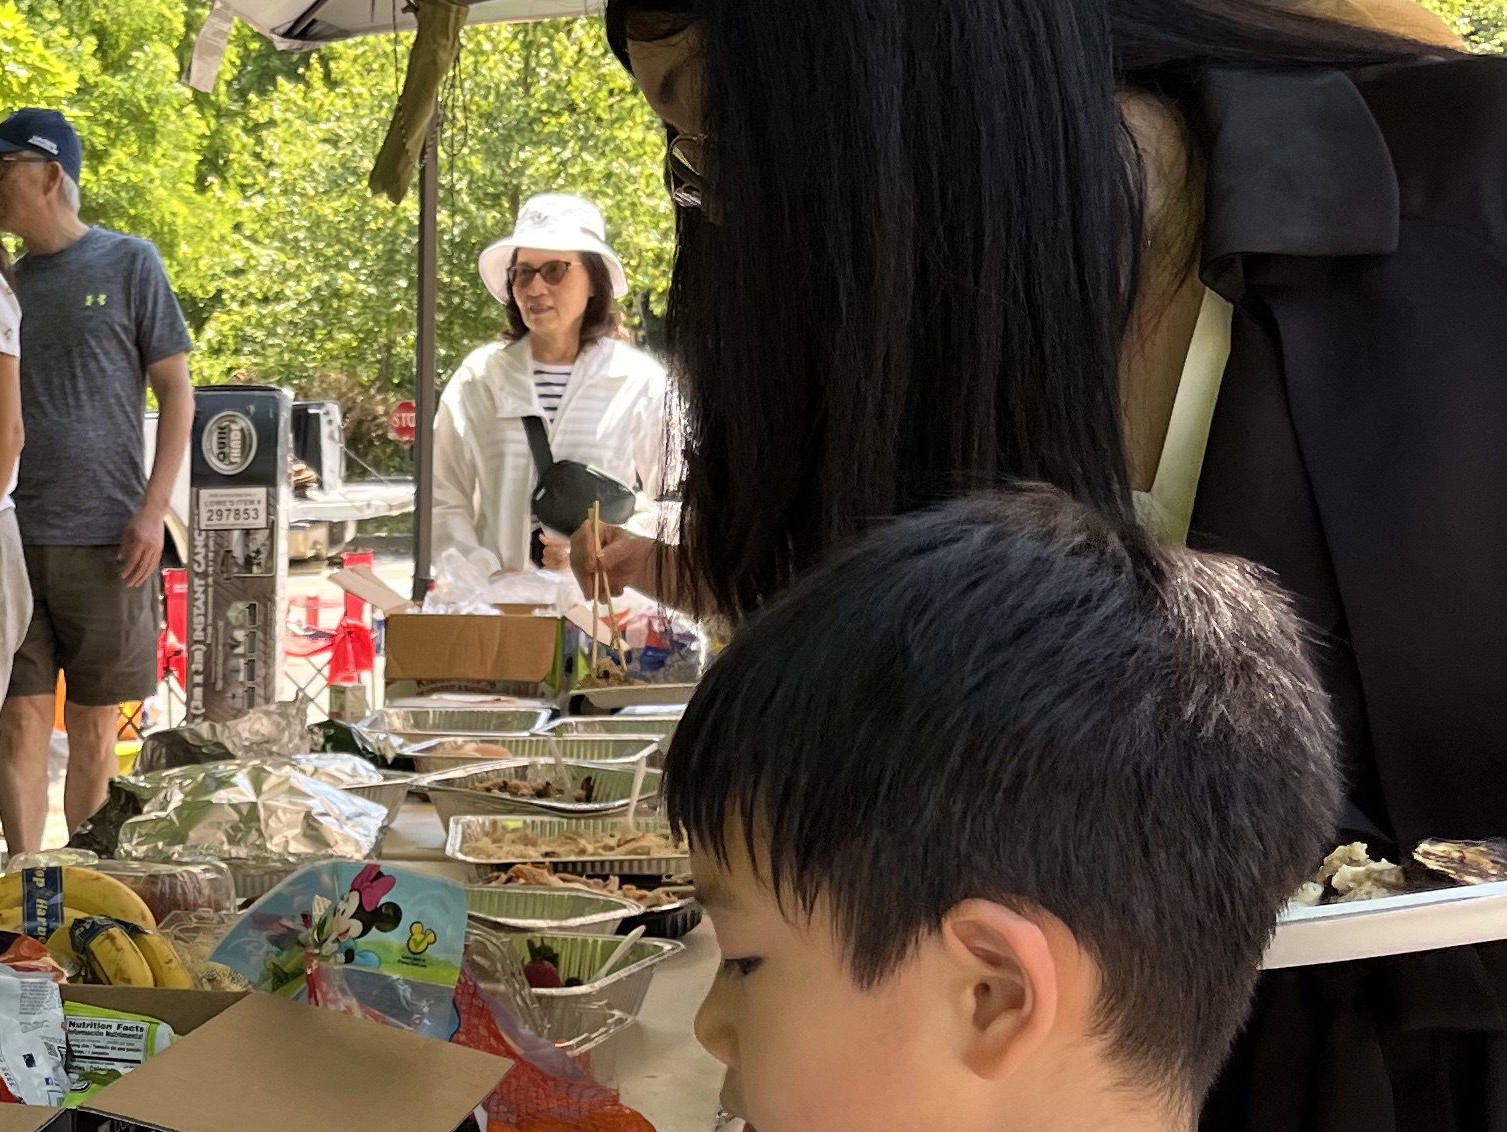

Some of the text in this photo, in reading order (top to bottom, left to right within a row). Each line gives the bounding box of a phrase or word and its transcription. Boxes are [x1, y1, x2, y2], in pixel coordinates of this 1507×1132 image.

[393, 412, 416, 428] STO
[206, 507, 260, 523] 297853
[192, 577, 206, 641] INSTANT
[68, 1020, 145, 1035] Nutrition Facts
